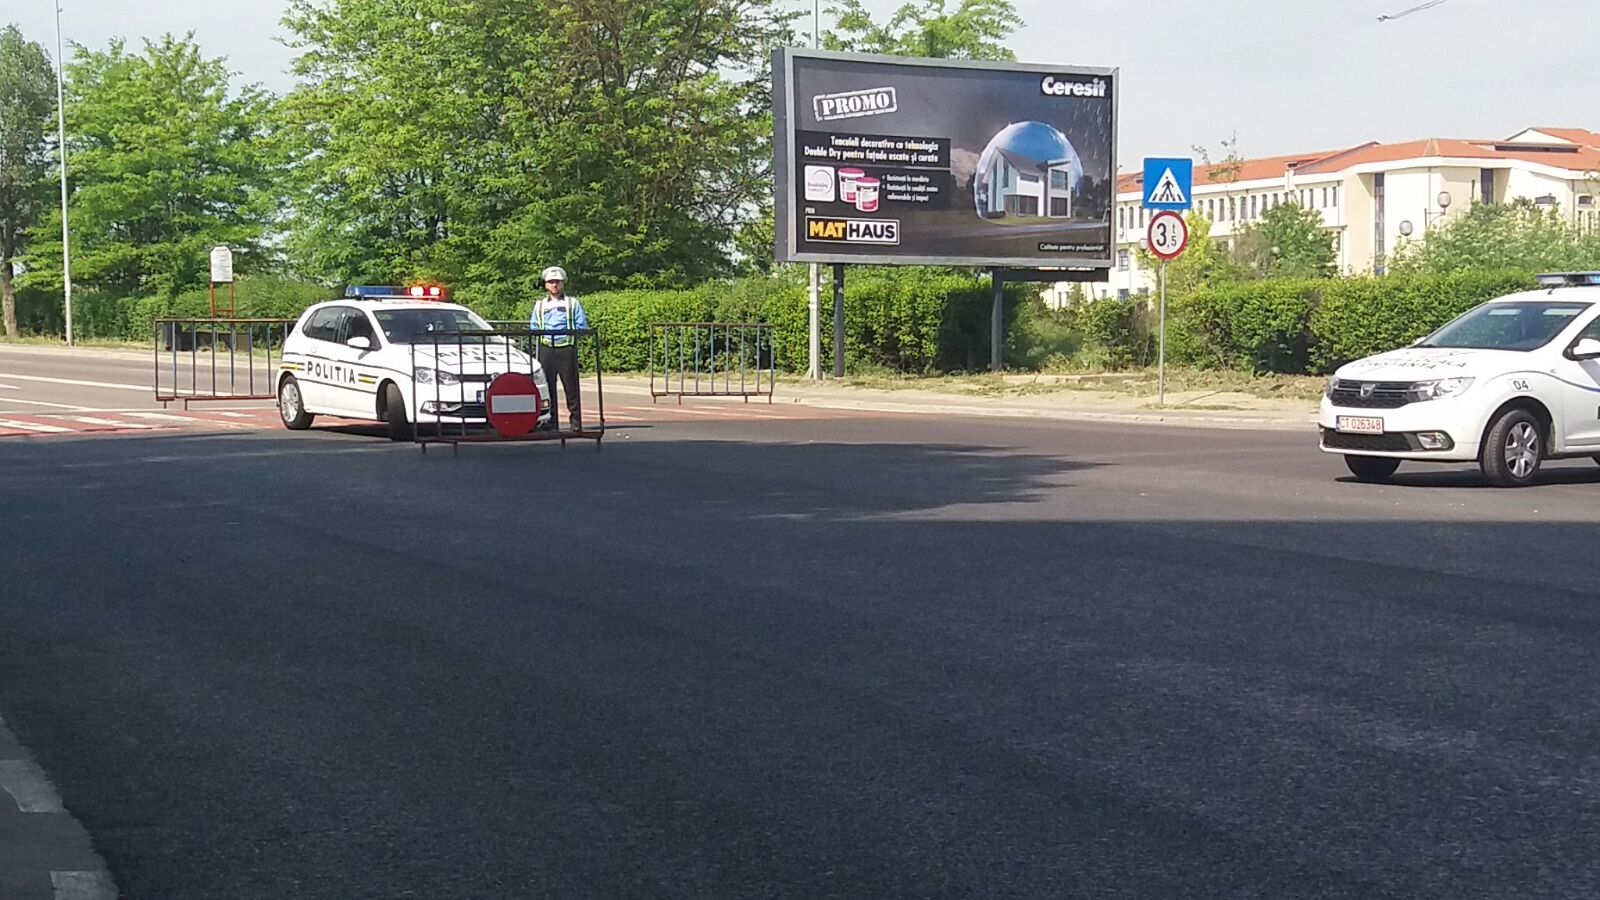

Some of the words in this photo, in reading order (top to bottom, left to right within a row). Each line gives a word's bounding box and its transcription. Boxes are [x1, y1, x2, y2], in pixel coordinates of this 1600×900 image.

[1042, 76, 1106, 97] Ceresit
[821, 92, 889, 115] PROMO
[804, 145, 828, 157] Double
[828, 147, 842, 160] Dry
[809, 220, 847, 238] MAT
[848, 223, 896, 239] HAUS
[307, 360, 356, 384] POLITIA
[1513, 380, 1530, 391] 04
